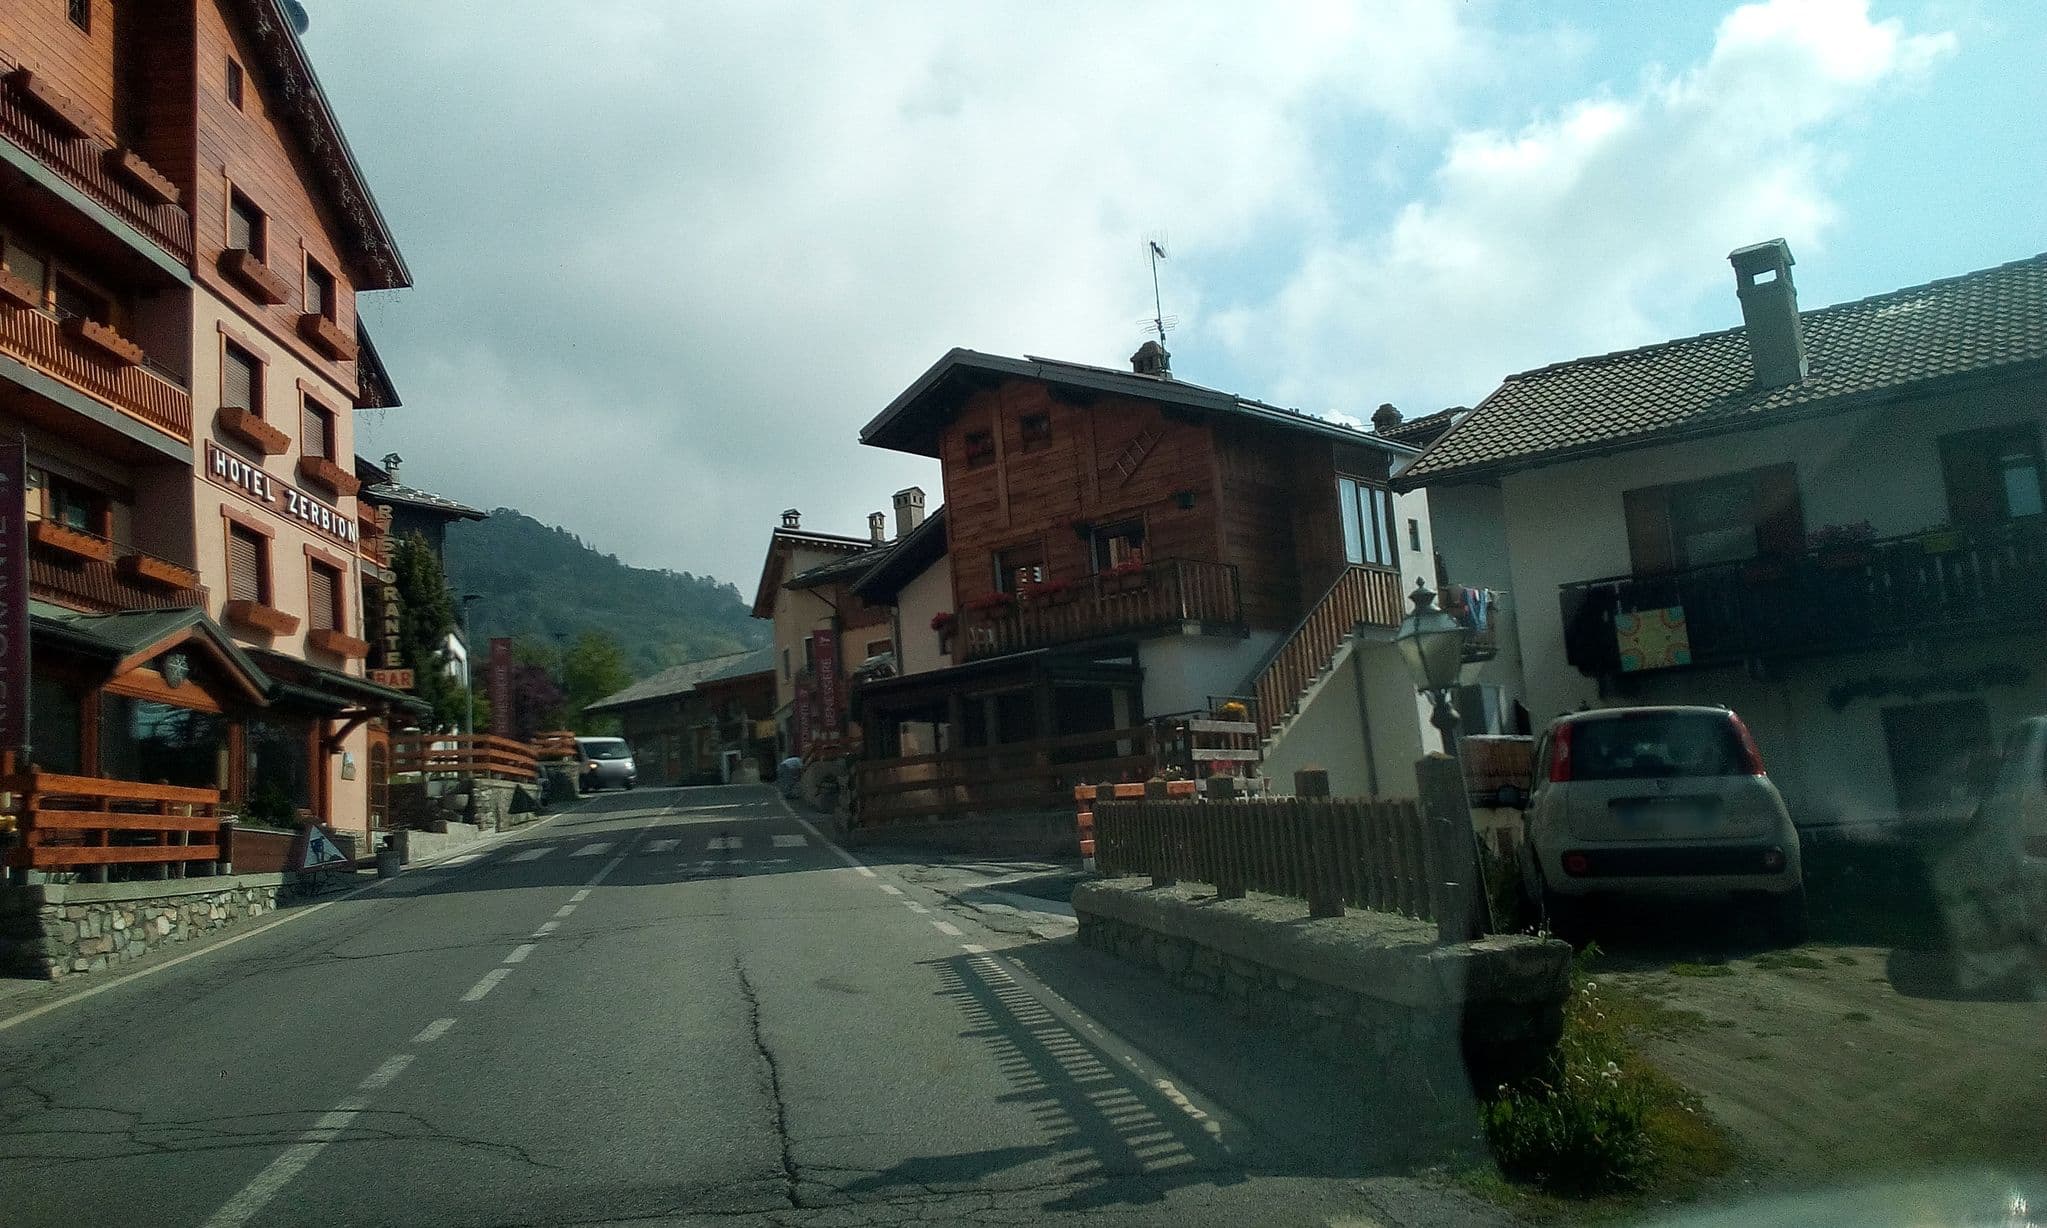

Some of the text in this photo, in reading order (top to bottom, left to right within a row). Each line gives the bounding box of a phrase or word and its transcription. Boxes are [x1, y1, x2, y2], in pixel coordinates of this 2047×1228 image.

[215, 449, 359, 543] HOTEL ZERBION
[378, 504, 401, 666] RISTORANTE
[375, 672, 411, 687] BAR
